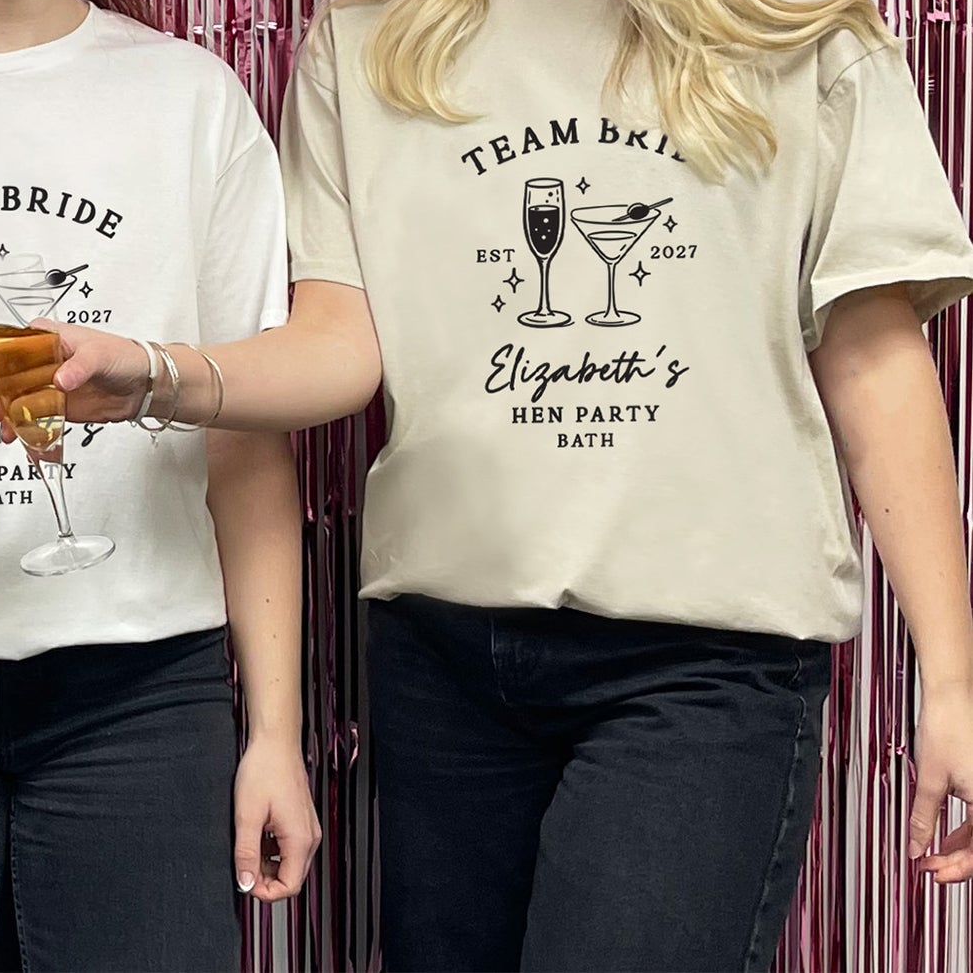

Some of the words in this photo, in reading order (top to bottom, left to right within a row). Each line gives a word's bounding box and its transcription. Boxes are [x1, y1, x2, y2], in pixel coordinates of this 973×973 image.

[461, 117, 580, 176] TEAM
[598, 117, 686, 163] BRI
[0, 185, 123, 239] BRIDE
[476, 248, 516, 263] EST
[650, 244, 698, 260] 2027
[67, 309, 112, 324] 2027
[484, 343, 690, 403] Elizabeth's
[511, 406, 564, 424] HEN
[575, 404, 660, 423] PARTY
[557, 432, 614, 448] BATH
